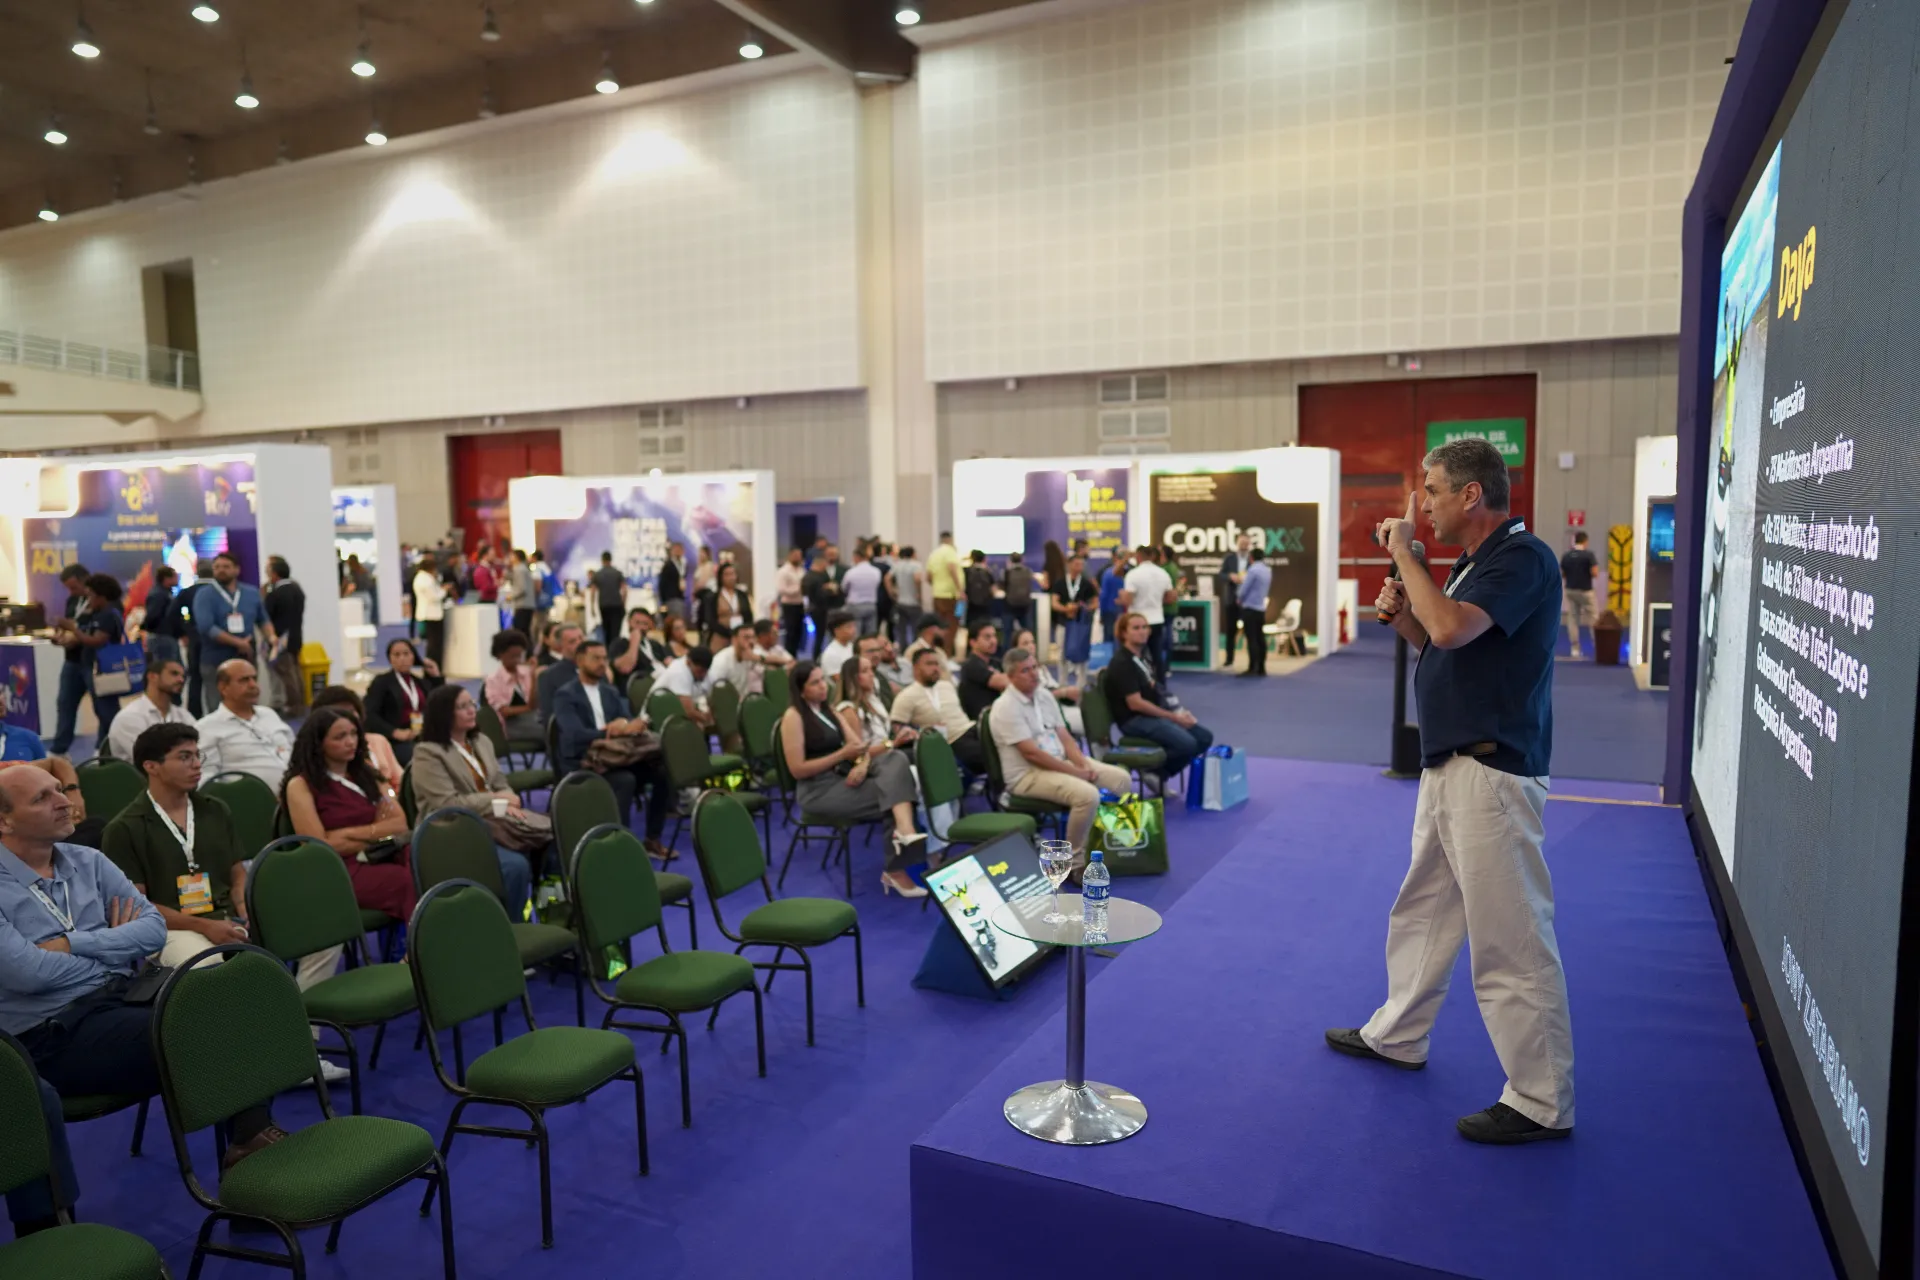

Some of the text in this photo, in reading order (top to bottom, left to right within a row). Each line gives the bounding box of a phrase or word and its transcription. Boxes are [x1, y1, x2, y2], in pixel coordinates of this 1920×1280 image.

[1778, 226, 1816, 321] Daya
[1811, 433, 1853, 484] Argentina
[1814, 523, 1828, 551] um
[1829, 515, 1862, 558] trecho
[1862, 514, 1879, 561] da
[1783, 563, 1792, 596] de
[1801, 567, 1812, 604] km
[1813, 571, 1824, 609] de
[1825, 574, 1849, 627] ripio,
[1851, 590, 1874, 635] que
[1757, 642, 1789, 694] Gobernador
[1825, 706, 1838, 742] na
[1800, 622, 1810, 659] de
[1810, 626, 1828, 671] Três
[1828, 636, 1859, 693] Lagos
[1859, 664, 1868, 699] e
